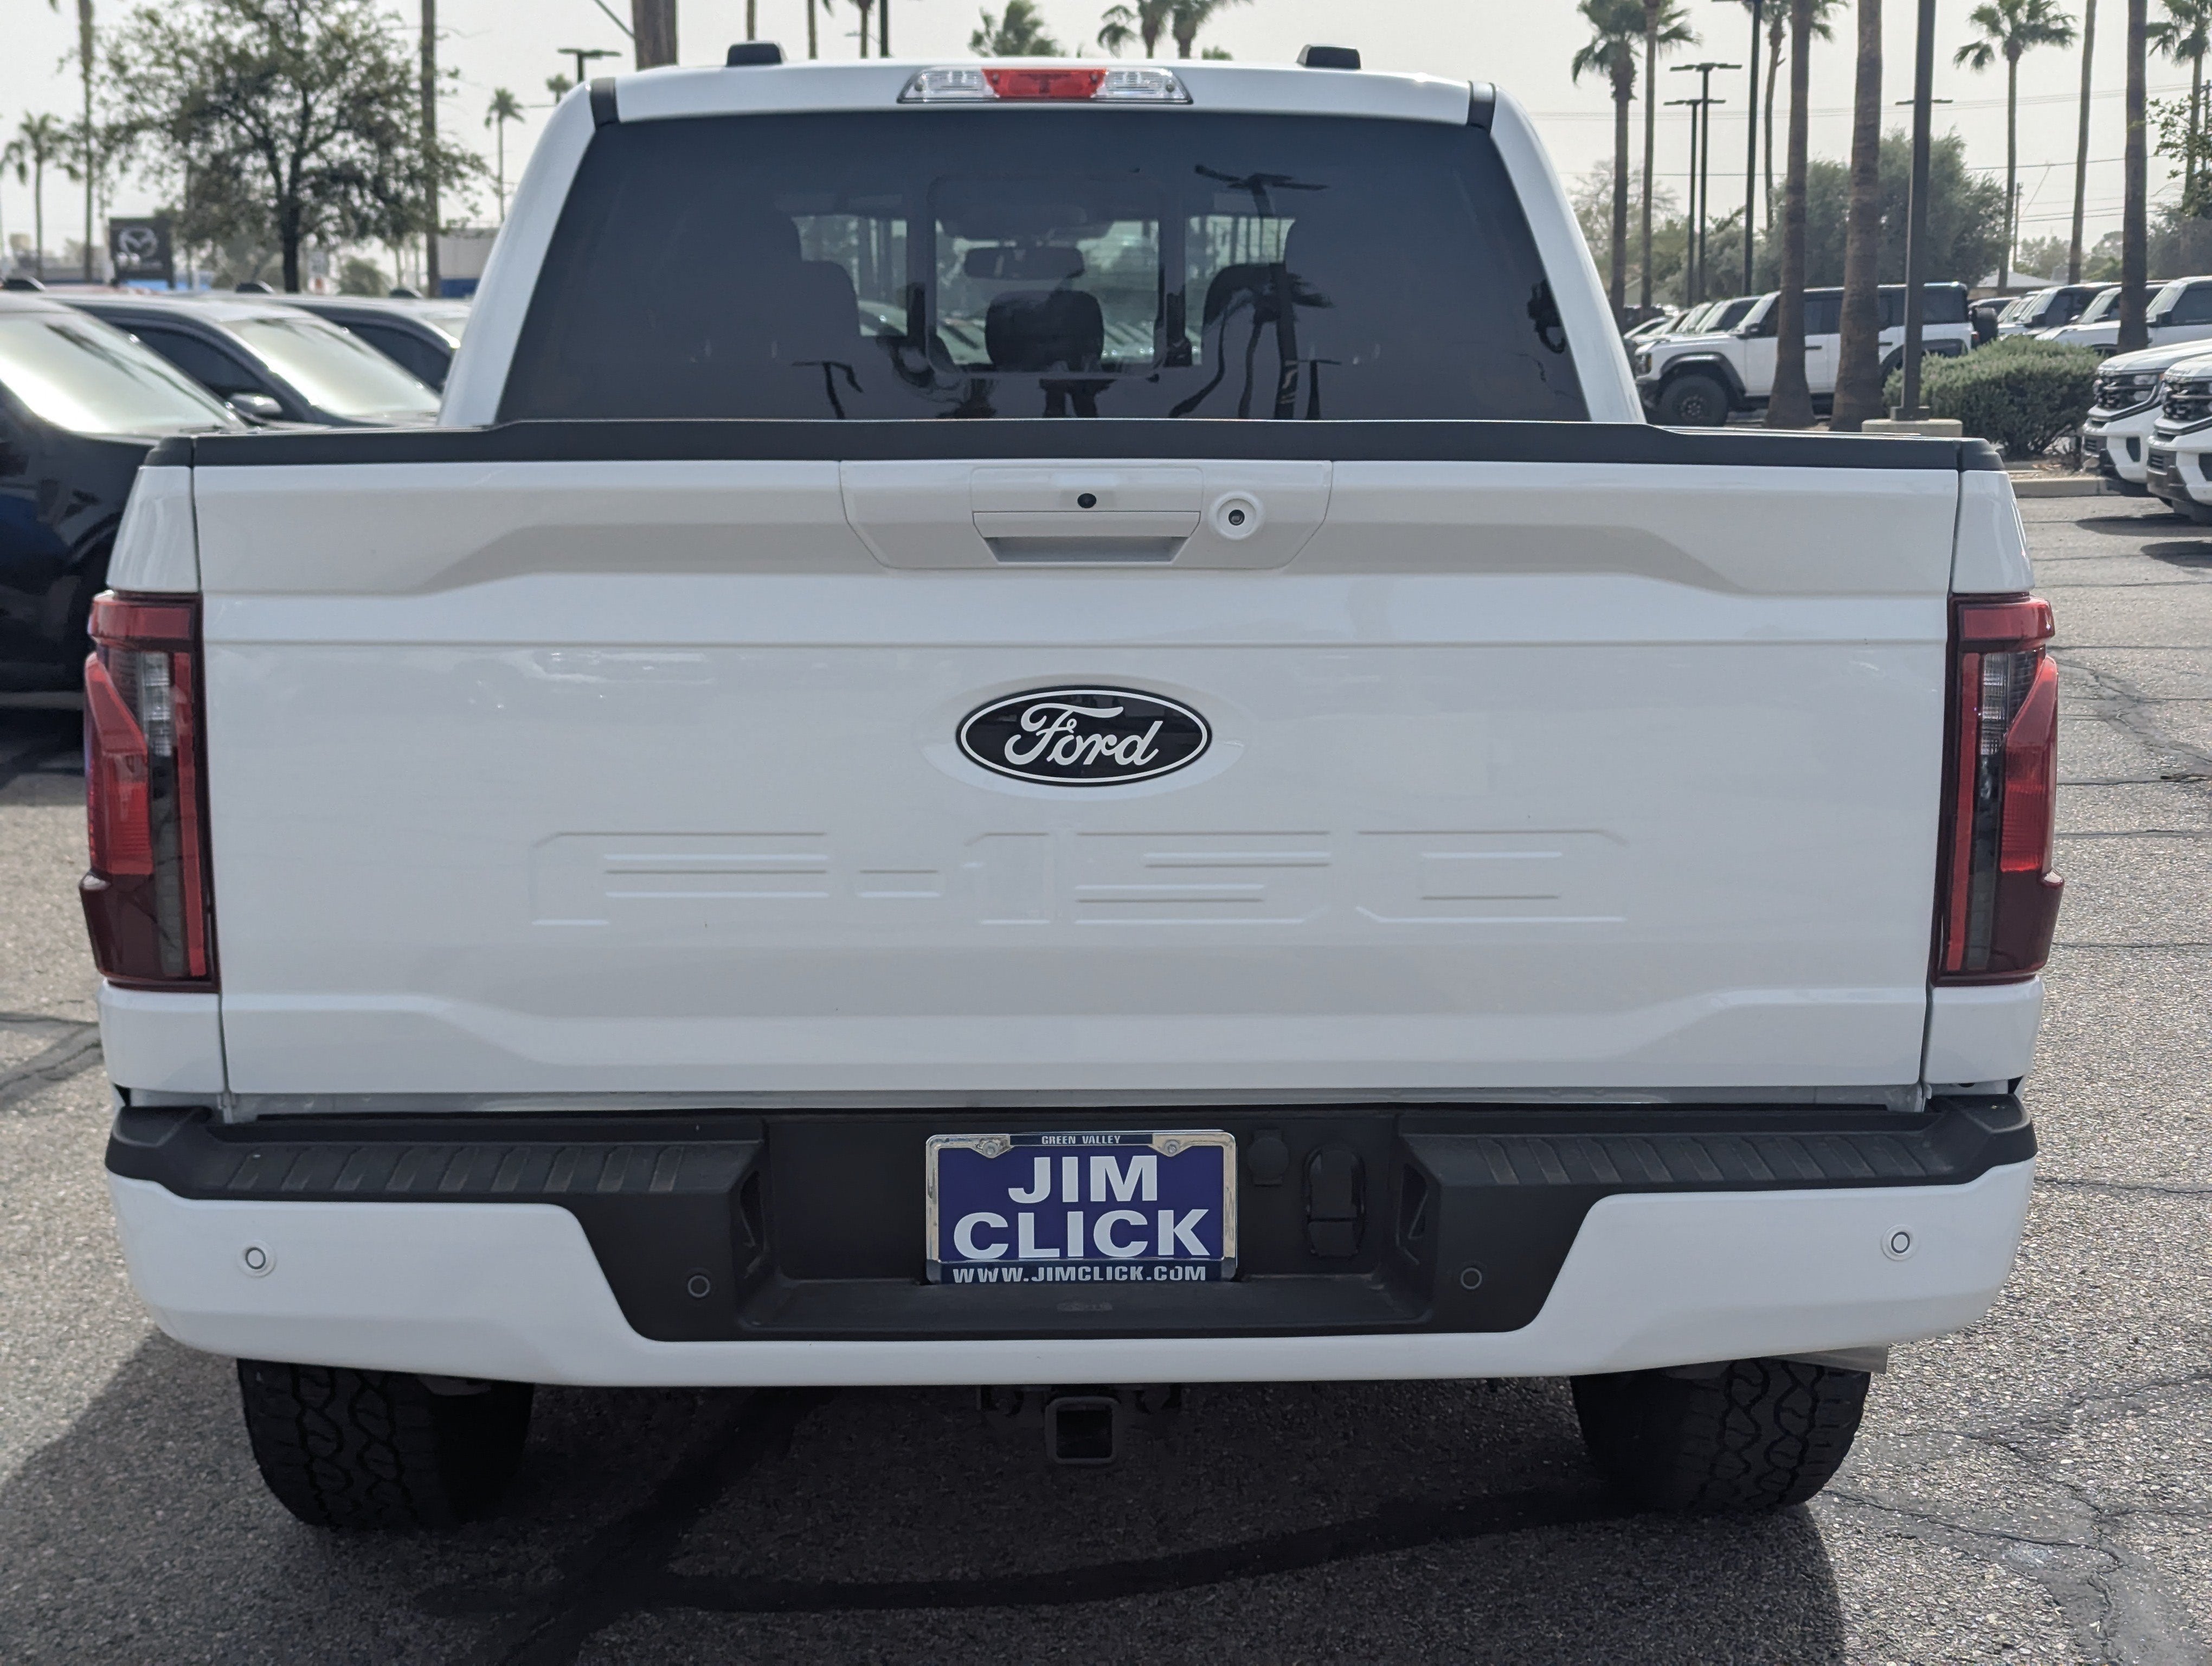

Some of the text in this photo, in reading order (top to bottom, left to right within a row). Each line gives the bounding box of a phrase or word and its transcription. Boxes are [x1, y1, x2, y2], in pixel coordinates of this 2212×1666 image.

[1005, 703, 1163, 765] Ford
[529, 830, 1629, 926] F-150
[1041, 1135, 1121, 1145] GREEN VALLEY
[1008, 1155, 1158, 1203] JIM
[954, 1209, 1210, 1259] CLICK
[953, 1265, 1206, 1284] WWW.JIMCLICK.COM
